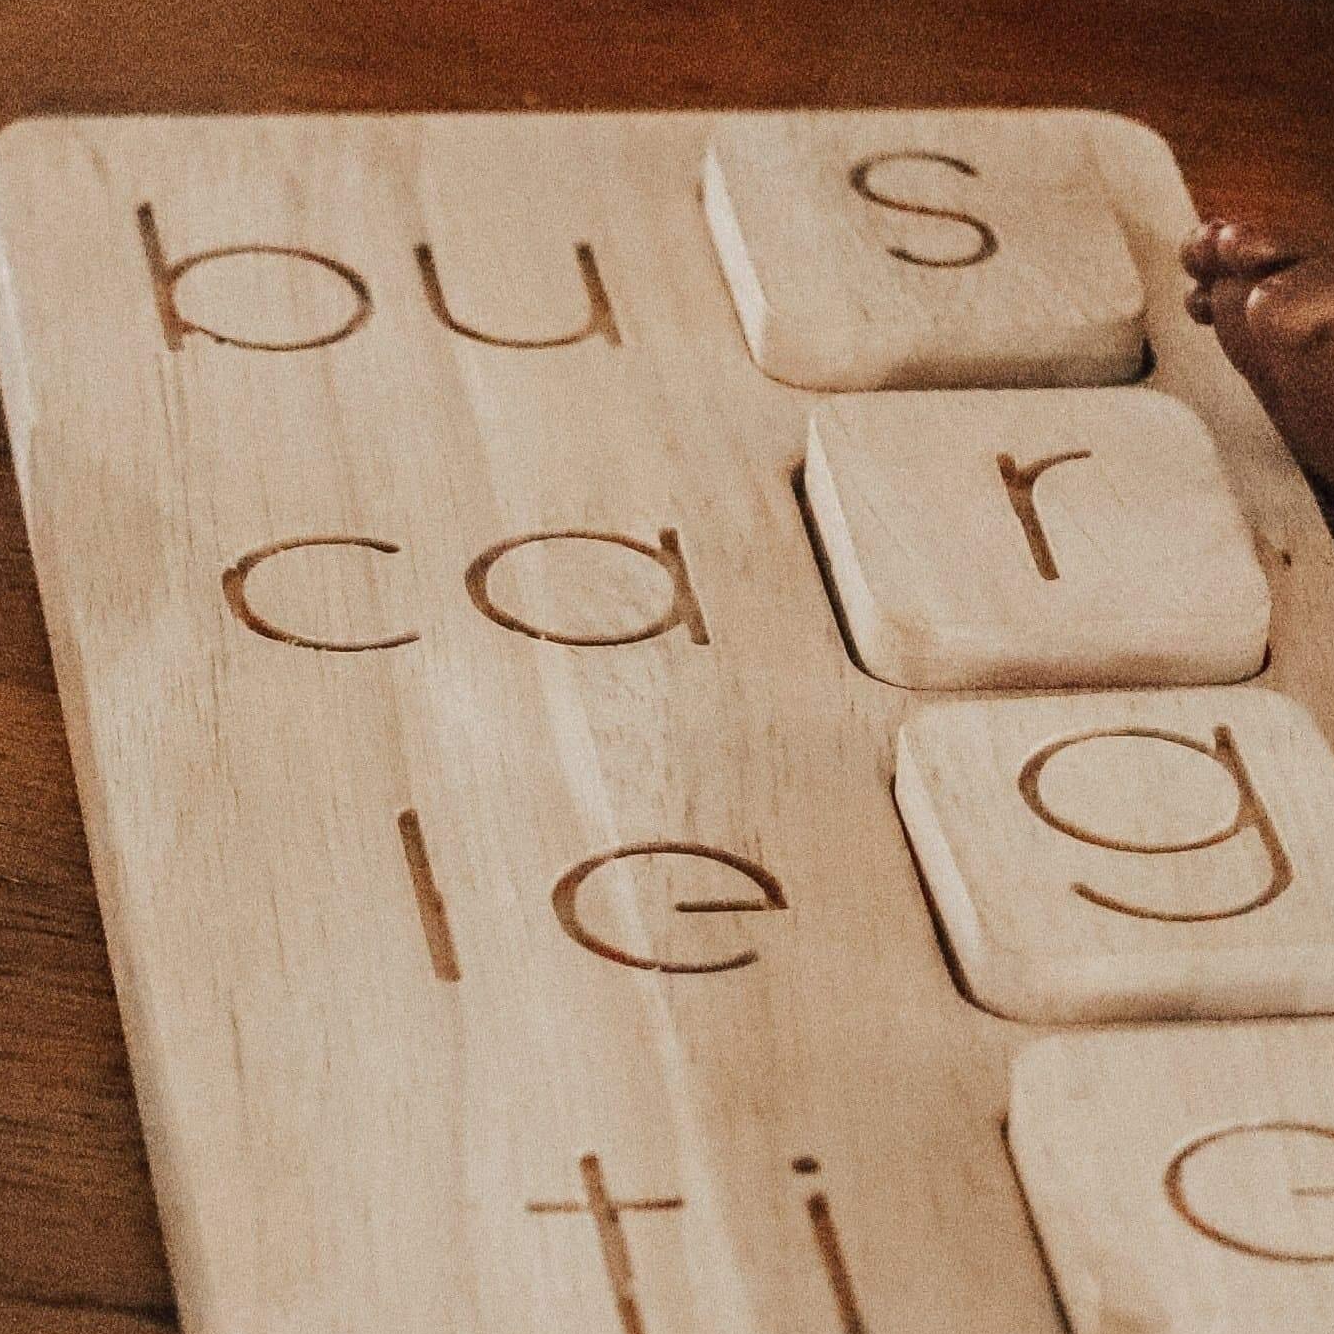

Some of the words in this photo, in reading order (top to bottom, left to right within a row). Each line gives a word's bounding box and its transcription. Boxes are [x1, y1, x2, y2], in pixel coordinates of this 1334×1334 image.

[136, 150, 998, 351] bus
[223, 449, 1091, 652] car
[398, 725, 1294, 981] leg
